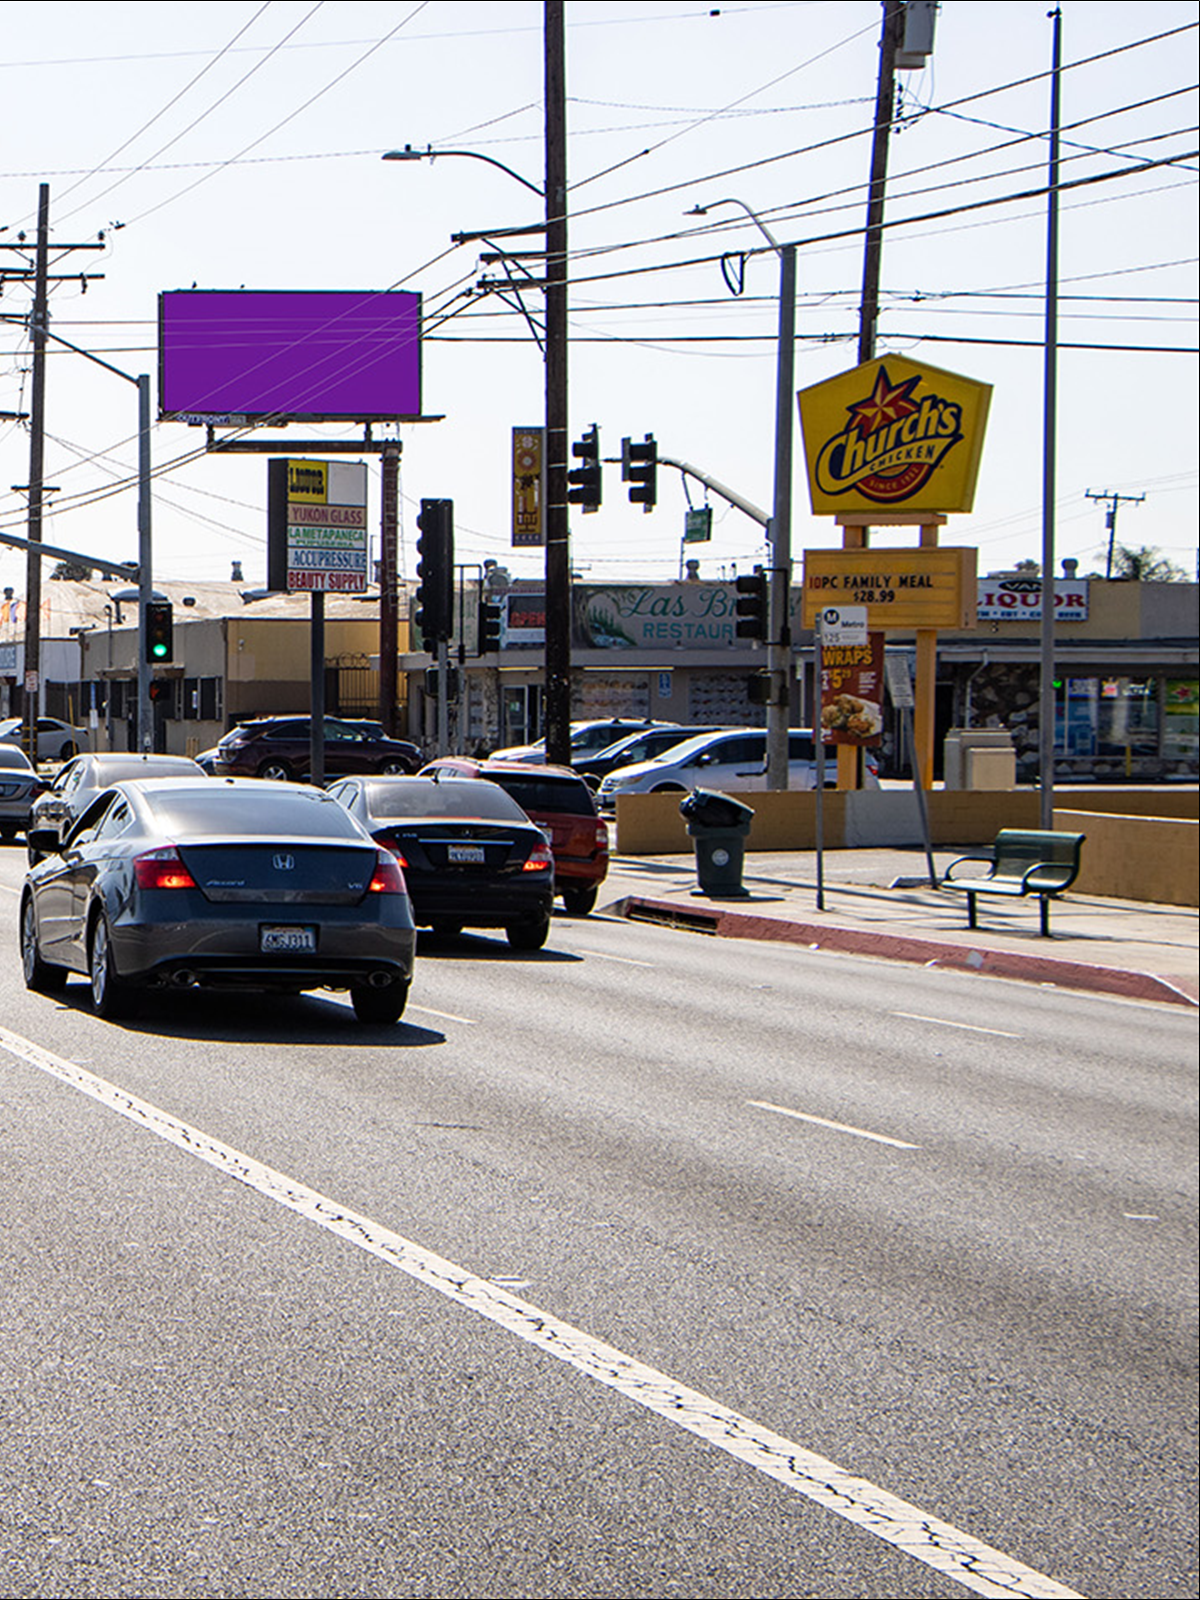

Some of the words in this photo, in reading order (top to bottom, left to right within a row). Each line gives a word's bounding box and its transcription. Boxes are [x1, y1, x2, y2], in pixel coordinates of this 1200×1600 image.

[817, 399, 960, 493] Church's
[870, 445, 935, 471] CHICKEN
[292, 507, 328, 522] YUKON
[330, 509, 362, 524] GLASS
[294, 550, 366, 568] ACCUPRESSURE
[288, 571, 326, 588] BEAUTY
[328, 573, 365, 590] SUPPLY
[809, 576, 838, 589] 10PC
[844, 576, 891, 588] FAMILY
[899, 575, 933, 588] MEAL
[618, 591, 688, 618] Las
[853, 590, 895, 602] $28.99
[977, 593, 1086, 609] IQUR
[824, 633, 839, 643] 125
[821, 650, 873, 666] WRAPS
